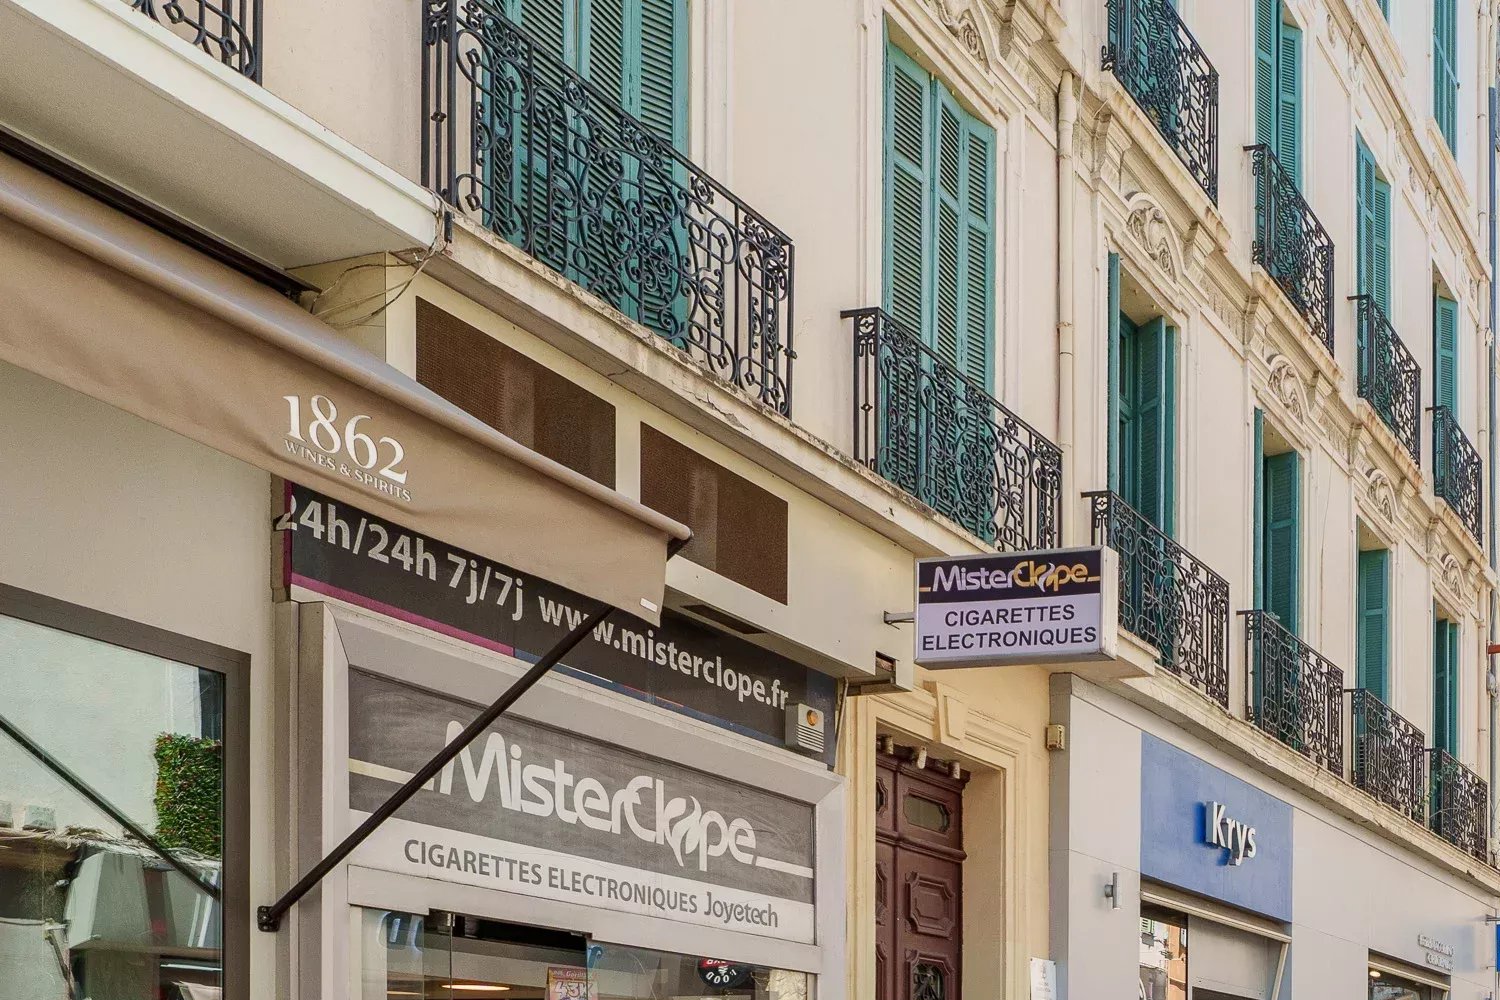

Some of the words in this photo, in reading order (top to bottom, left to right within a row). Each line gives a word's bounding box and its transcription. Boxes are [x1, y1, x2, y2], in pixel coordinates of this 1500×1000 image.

[283, 394, 409, 484] 1862
[284, 439, 337, 472] WINES
[340, 462, 352, 478] &
[354, 469, 412, 502] SPIRITS
[276, 495, 437, 581] 24h/24h
[447, 552, 523, 622] 7j/7j
[538, 596, 789, 710] www.misterclope.fr
[945, 604, 1076, 627] CIGARETTES
[922, 626, 1097, 651] ELECTRONIQUES
[1209, 801, 1257, 867] Krys
[404, 838, 542, 885] CIGARETTES
[547, 866, 698, 914] ELECTRONIQUES
[704, 891, 779, 929] Joyetech
